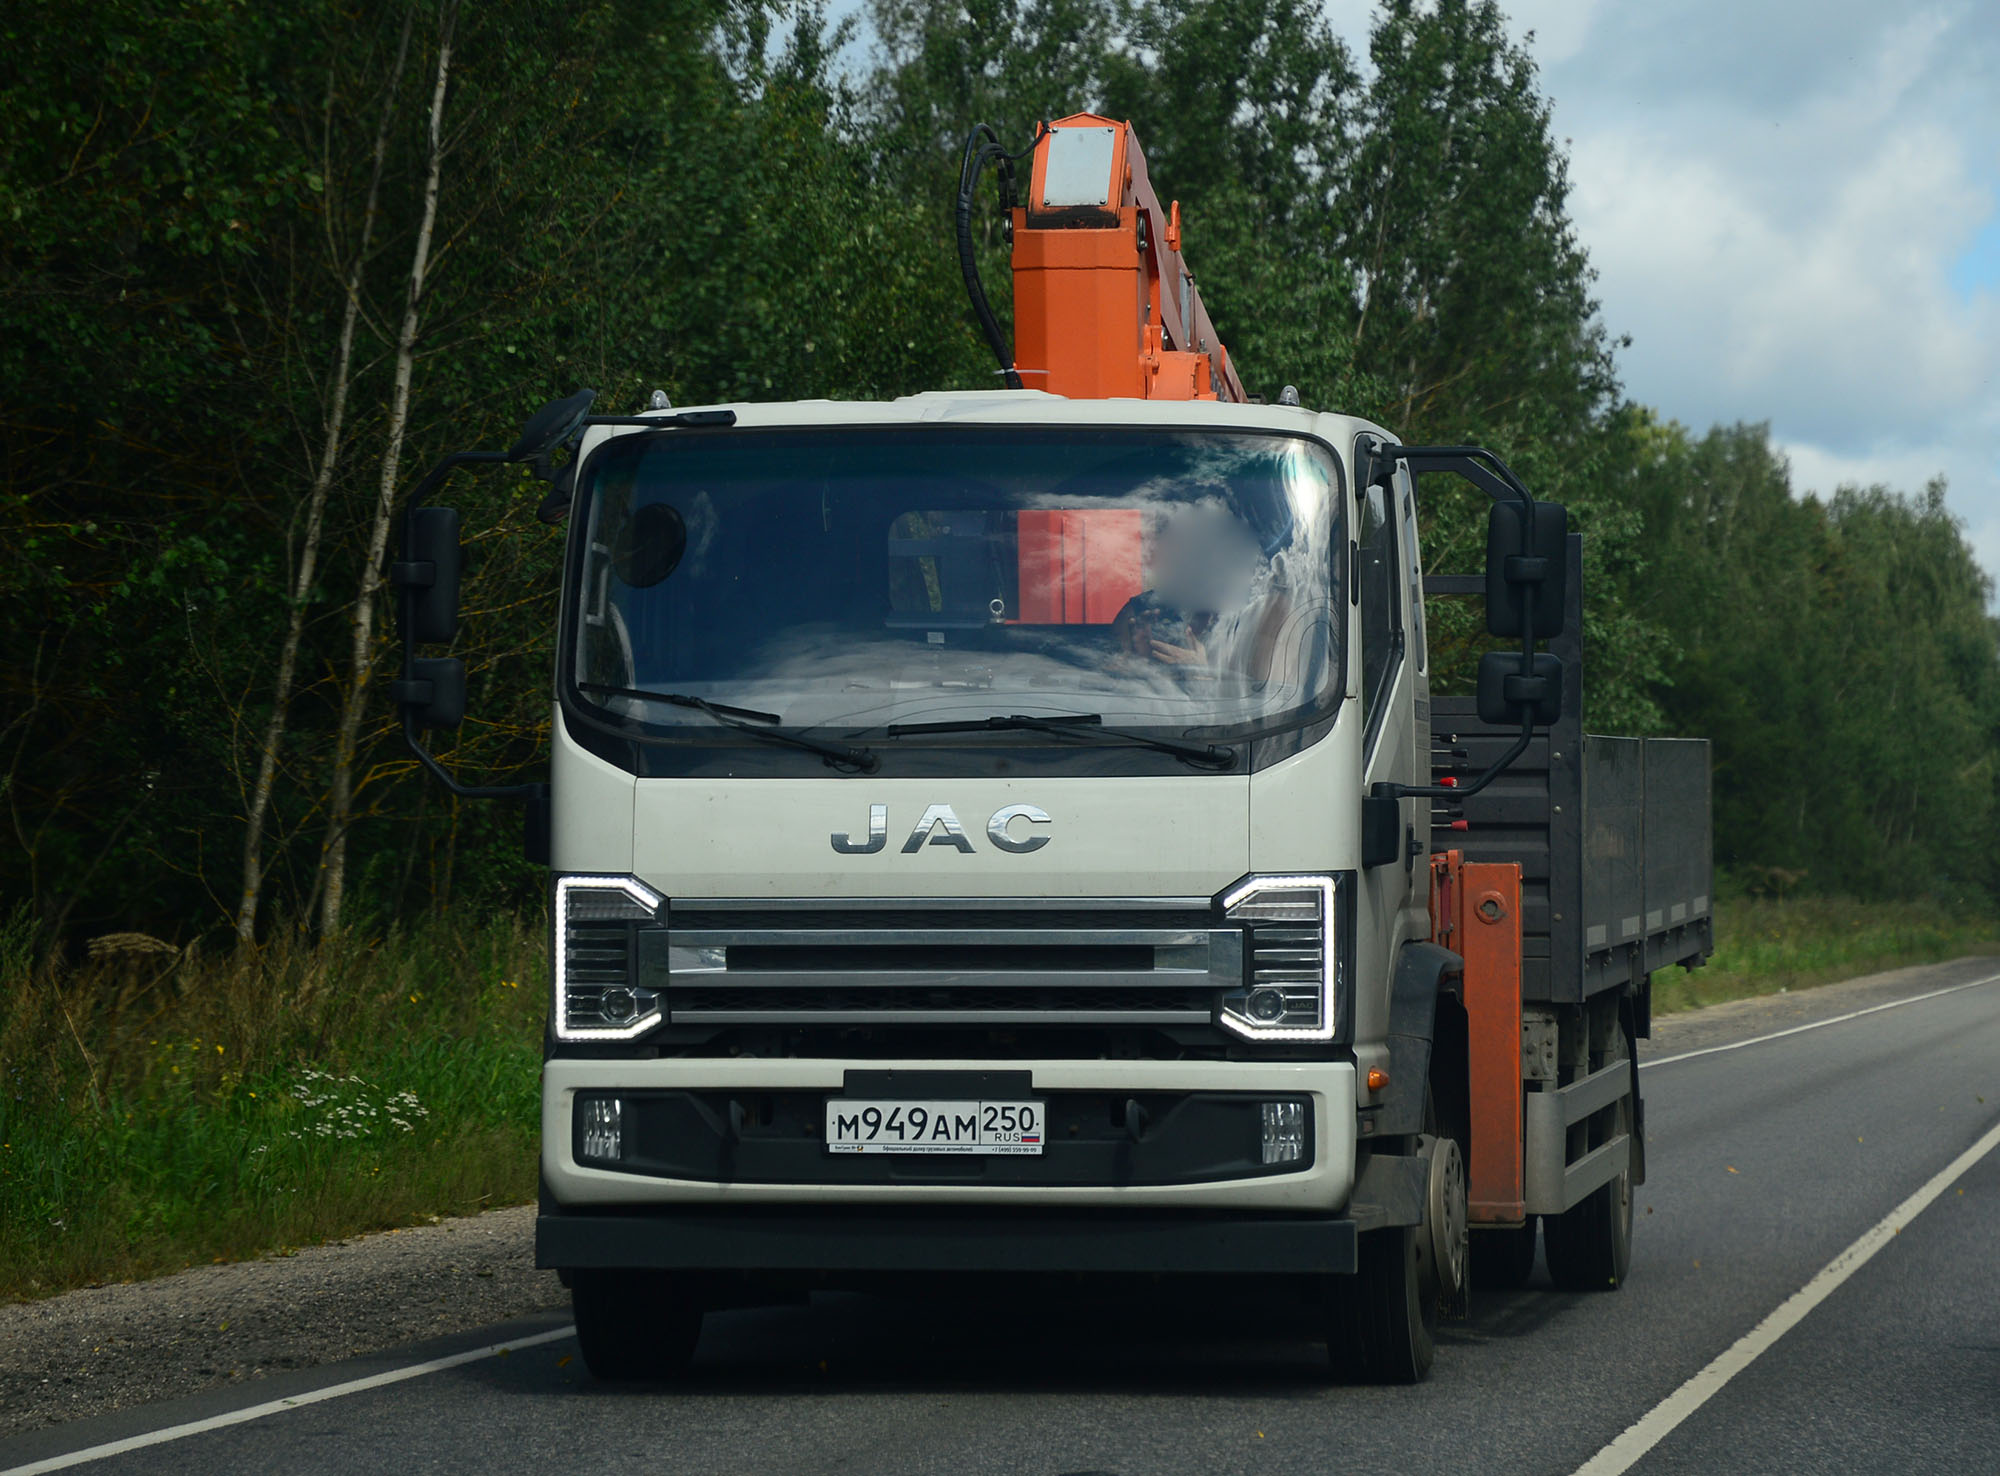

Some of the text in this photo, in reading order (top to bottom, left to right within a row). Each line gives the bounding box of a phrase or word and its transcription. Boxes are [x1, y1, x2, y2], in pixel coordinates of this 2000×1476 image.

[830, 803, 1052, 854] JAC
[983, 1106, 1035, 1132] 250
[995, 1133, 1020, 1142] RUS
